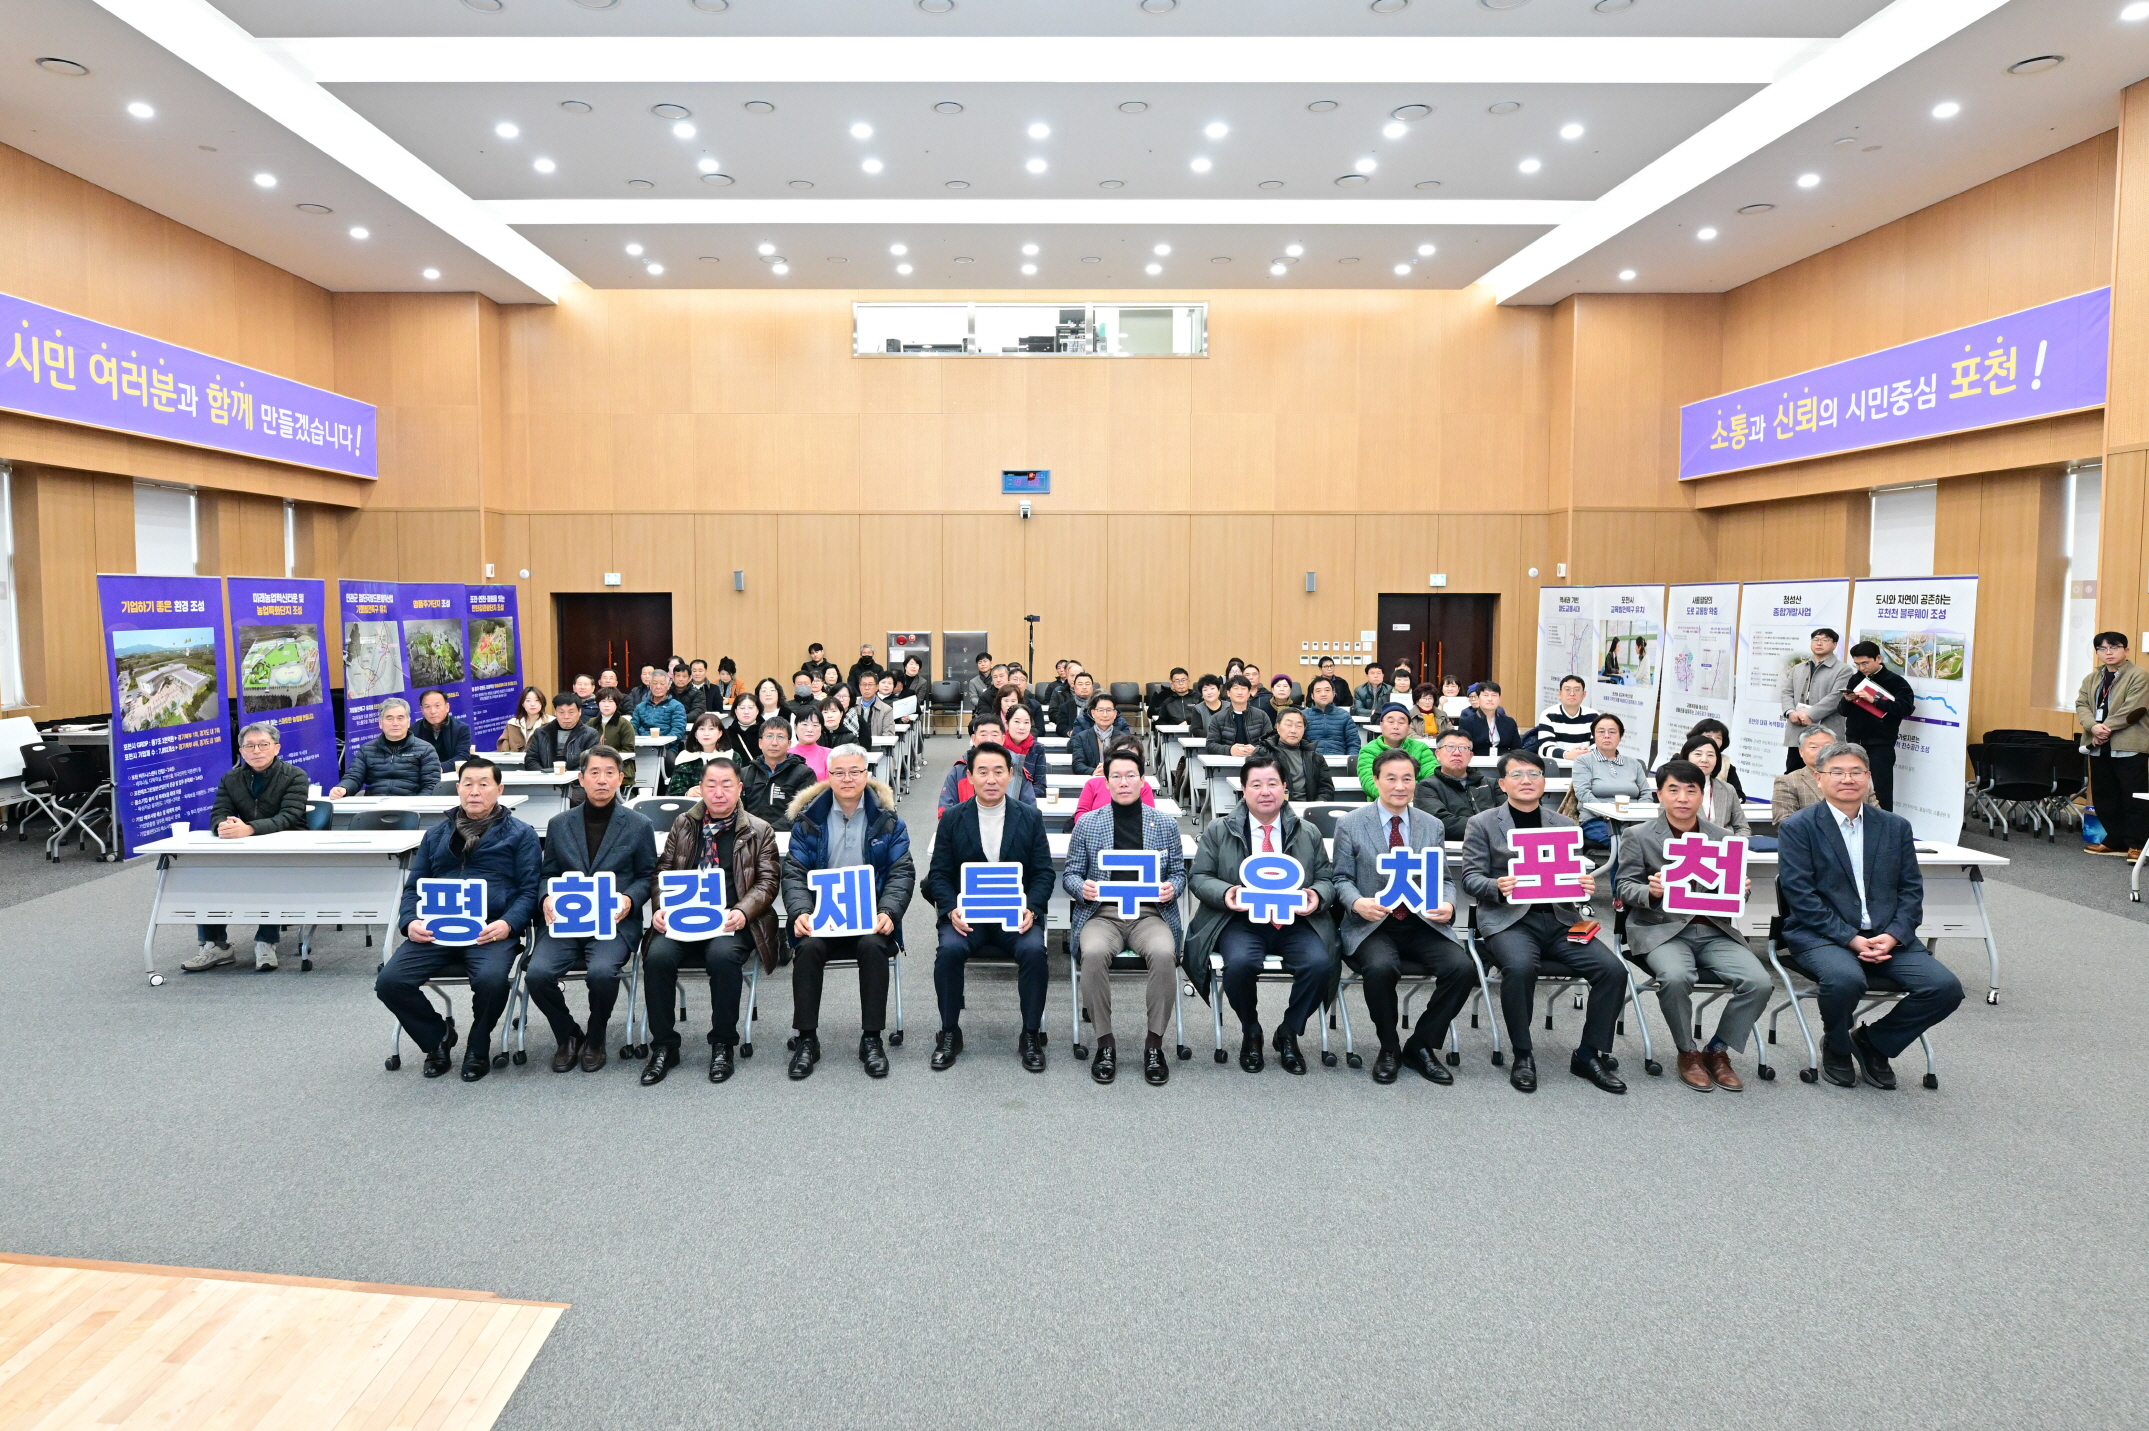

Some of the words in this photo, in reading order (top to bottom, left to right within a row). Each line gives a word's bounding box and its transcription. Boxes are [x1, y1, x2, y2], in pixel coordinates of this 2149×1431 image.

[6, 325, 76, 391] 시민
[89, 347, 199, 417] 여러분과
[206, 378, 254, 430] 함께
[260, 403, 363, 457] 만들겠습니다!
[1710, 411, 1765, 450] 소통과
[1773, 393, 1839, 440] 신뢰의
[1845, 373, 1937, 422] 시민중심
[1948, 340, 2017, 399] 포천
[441, 599, 451, 608] 조성
[1621, 596, 1634, 604] 포천시
[1783, 595, 1802, 605] 청성산
[1875, 594, 1896, 605] 도시와
[1897, 594, 1919, 605] 자연이
[1920, 594, 1951, 605] 공존하는
[121, 600, 155, 613] 기업하기
[156, 600, 172, 613] 좋은
[174, 600, 189, 612] 환경
[190, 600, 205, 612] 조성
[256, 605, 292, 616] 농업특화단지
[292, 605, 303, 615] 조성
[1635, 605, 1645, 613] 유치
[1686, 607, 1695, 615] 도로
[1772, 607, 1812, 617] 종합개발사업
[1877, 608, 1899, 619] 포천천
[1900, 608, 1929, 619] 블루웨이
[1930, 608, 1947, 620] 조성
[1920, 745, 1930, 754] 조성
[421, 881, 487, 943] 평
[552, 876, 619, 936] 화
[663, 873, 728, 934] 경
[812, 867, 873, 931] 제
[961, 866, 1024, 928] 특
[1099, 854, 1163, 915] 구
[1239, 856, 1303, 920] 유
[1378, 851, 1441, 911] 치
[1511, 832, 1587, 901] 포
[1667, 837, 1746, 914] 천
